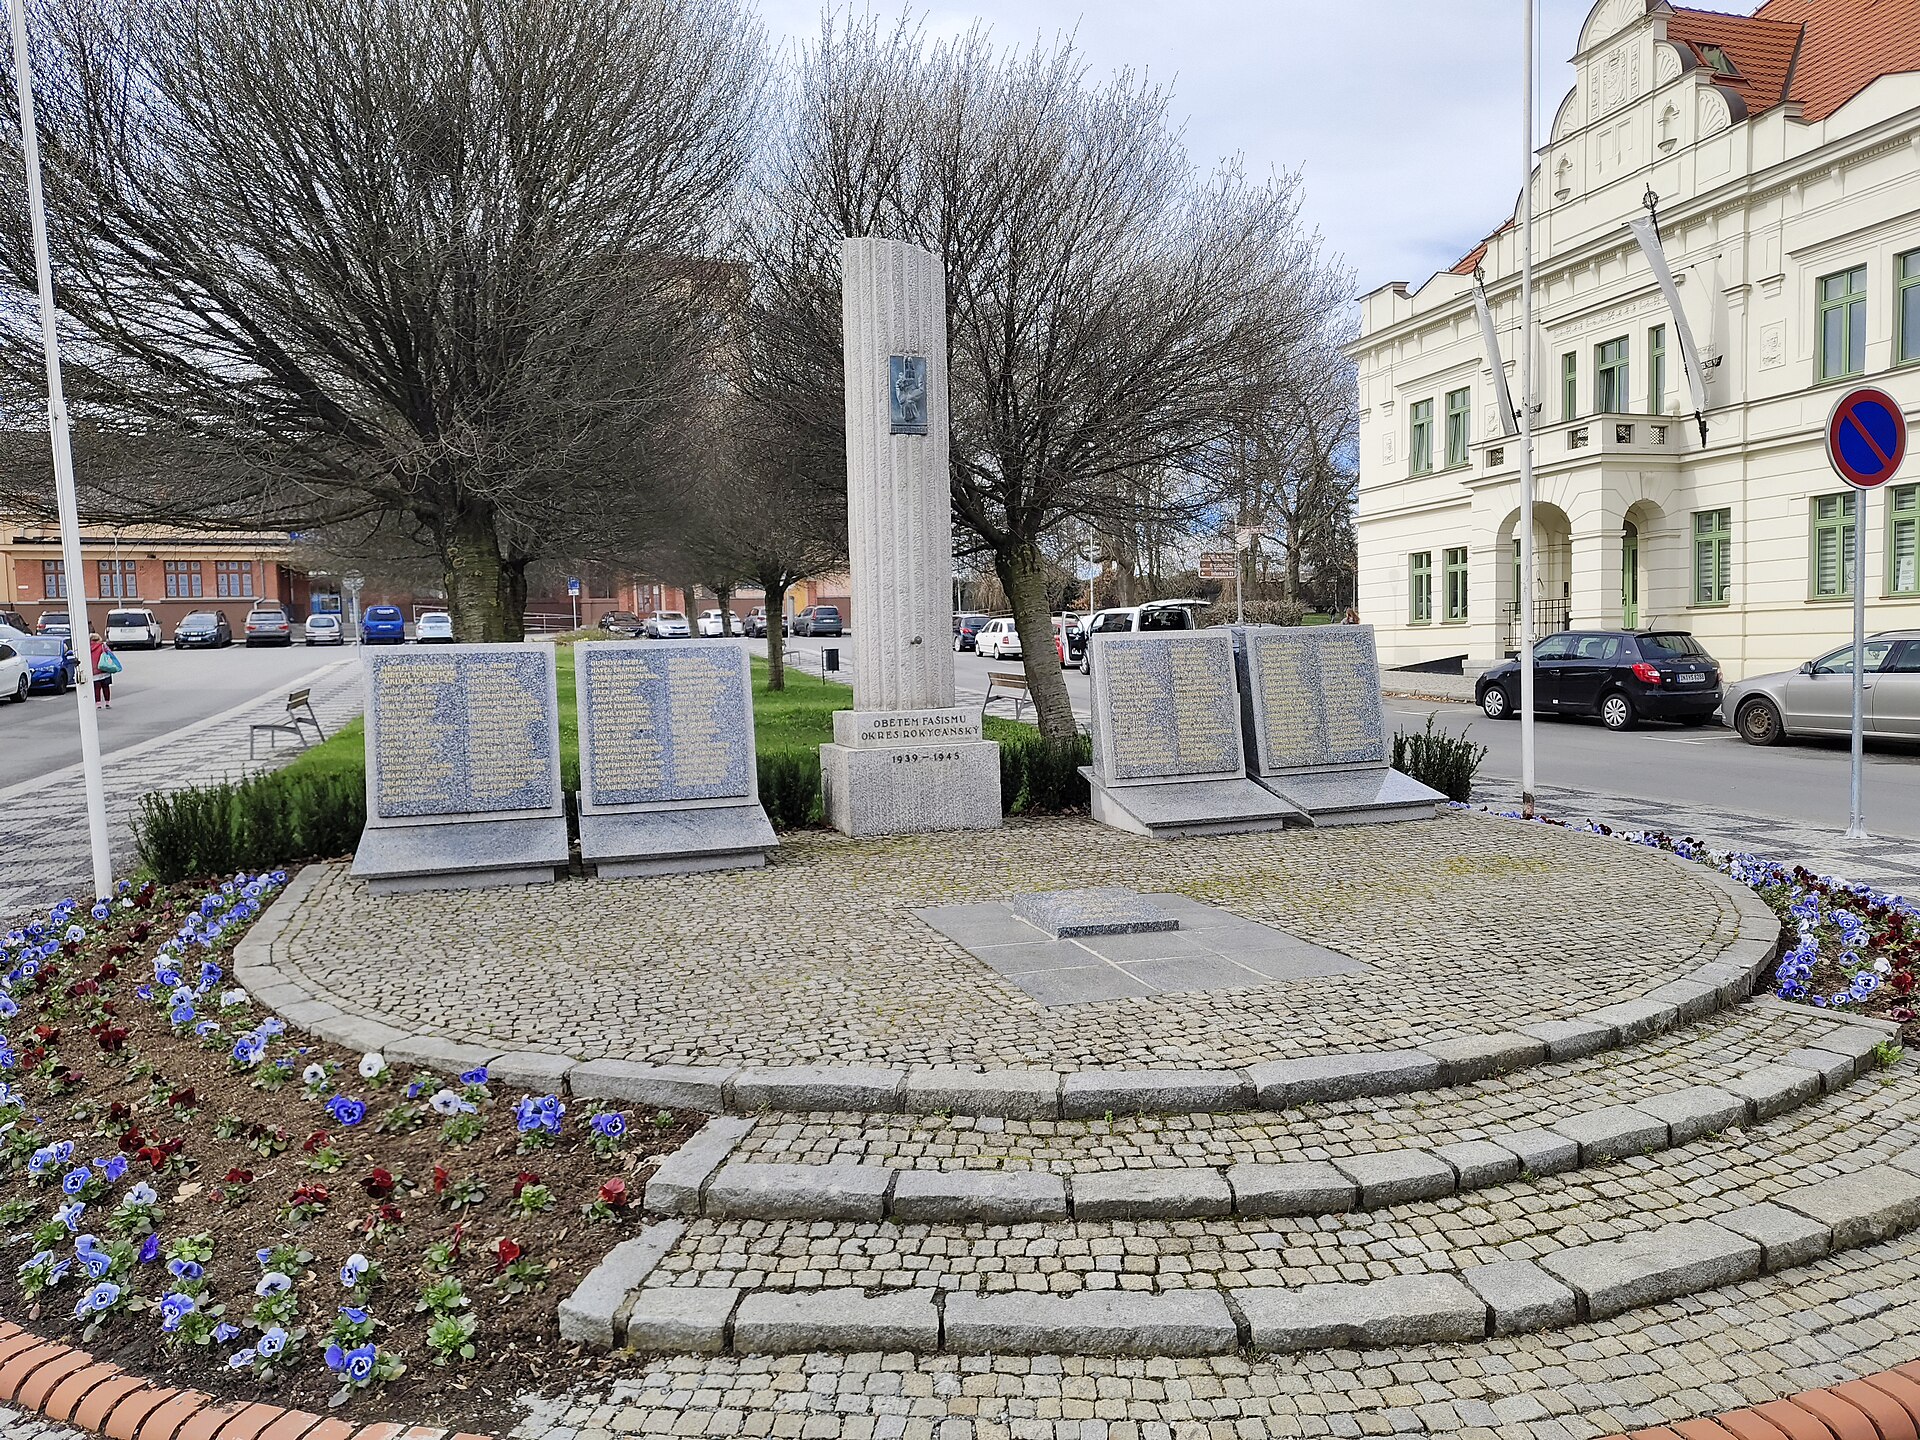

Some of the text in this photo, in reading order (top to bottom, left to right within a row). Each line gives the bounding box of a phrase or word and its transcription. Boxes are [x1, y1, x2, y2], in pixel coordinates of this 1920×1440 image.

[922, 715, 966, 726] FAŠISMU
[861, 725, 980, 741] OKRES ROKYCANSKÝ
[892, 753, 918, 764] 1939
[933, 752, 960, 762] 1945
